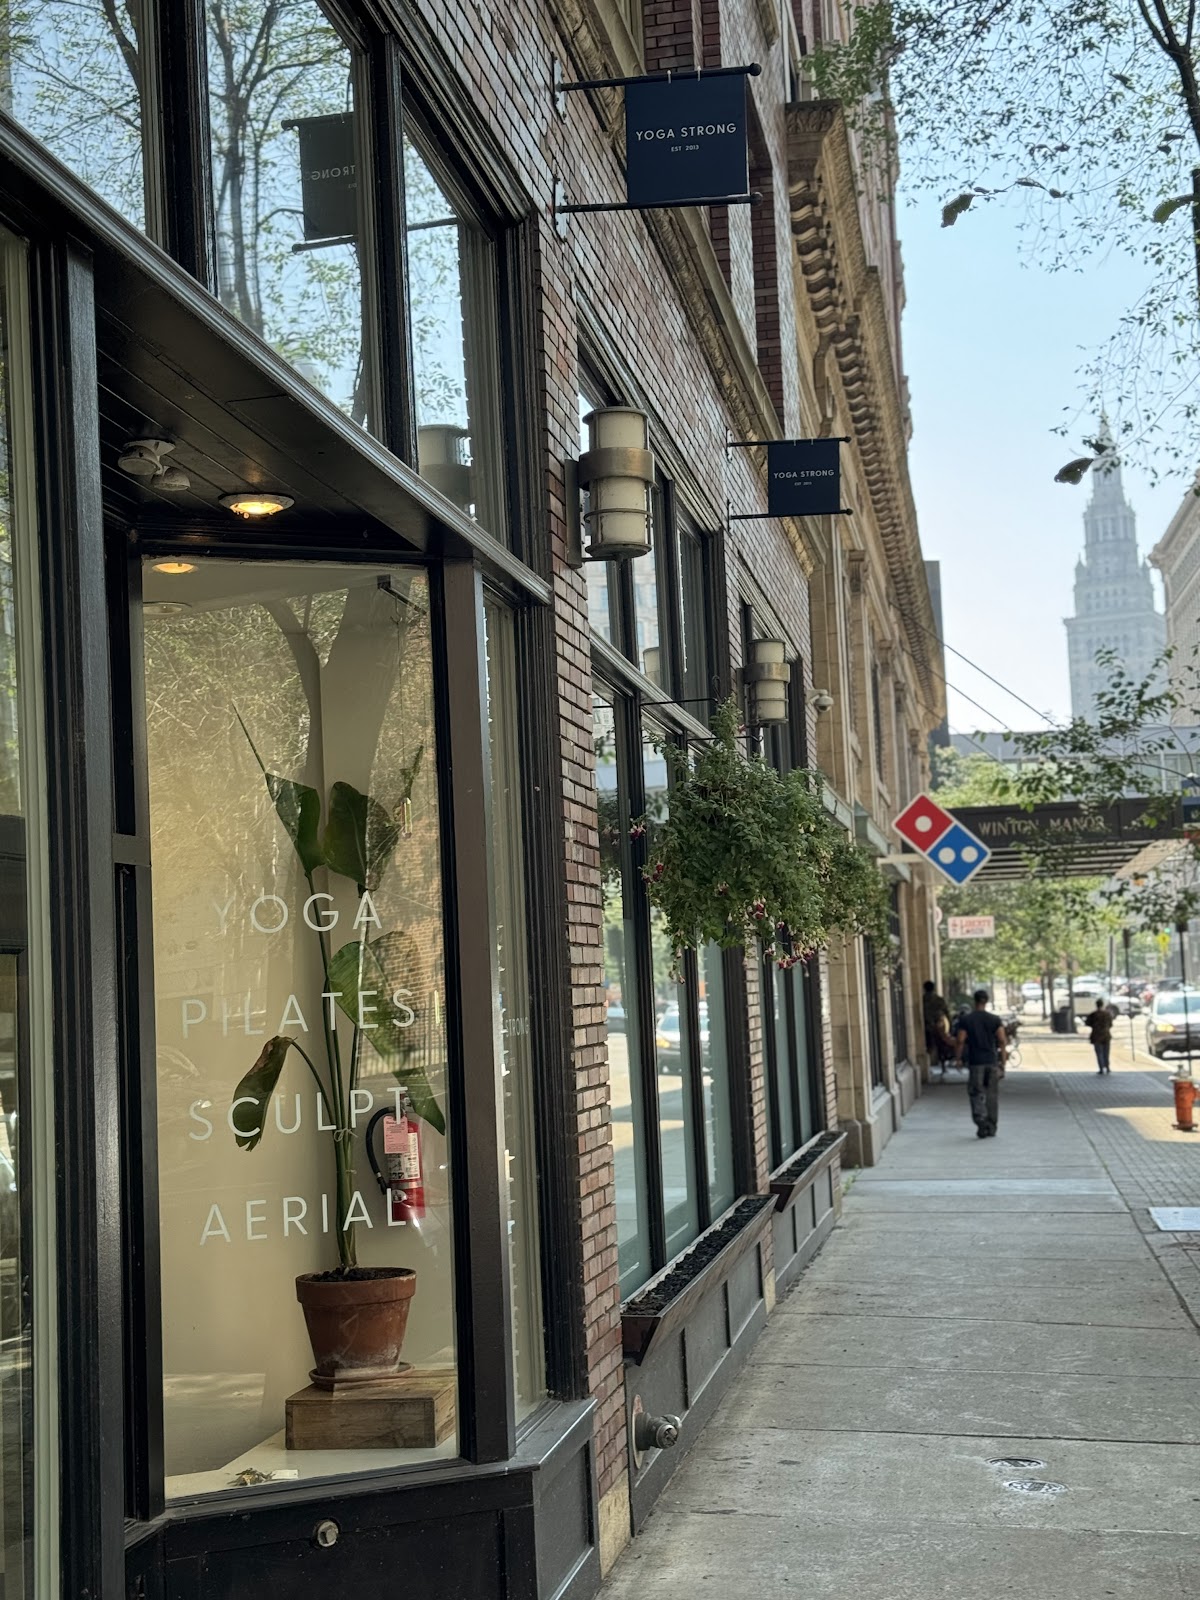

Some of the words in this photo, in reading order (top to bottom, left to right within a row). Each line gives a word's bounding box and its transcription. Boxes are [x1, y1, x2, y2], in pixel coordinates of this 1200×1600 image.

[636, 128, 675, 141] YOGA
[680, 123, 737, 137] STRONG
[800, 469, 834, 478] STRONG
[210, 890, 383, 934] YOGA
[182, 988, 415, 1039] PILATES
[188, 1086, 409, 1141] SCULPT
[200, 1187, 407, 1246] AERIAL
